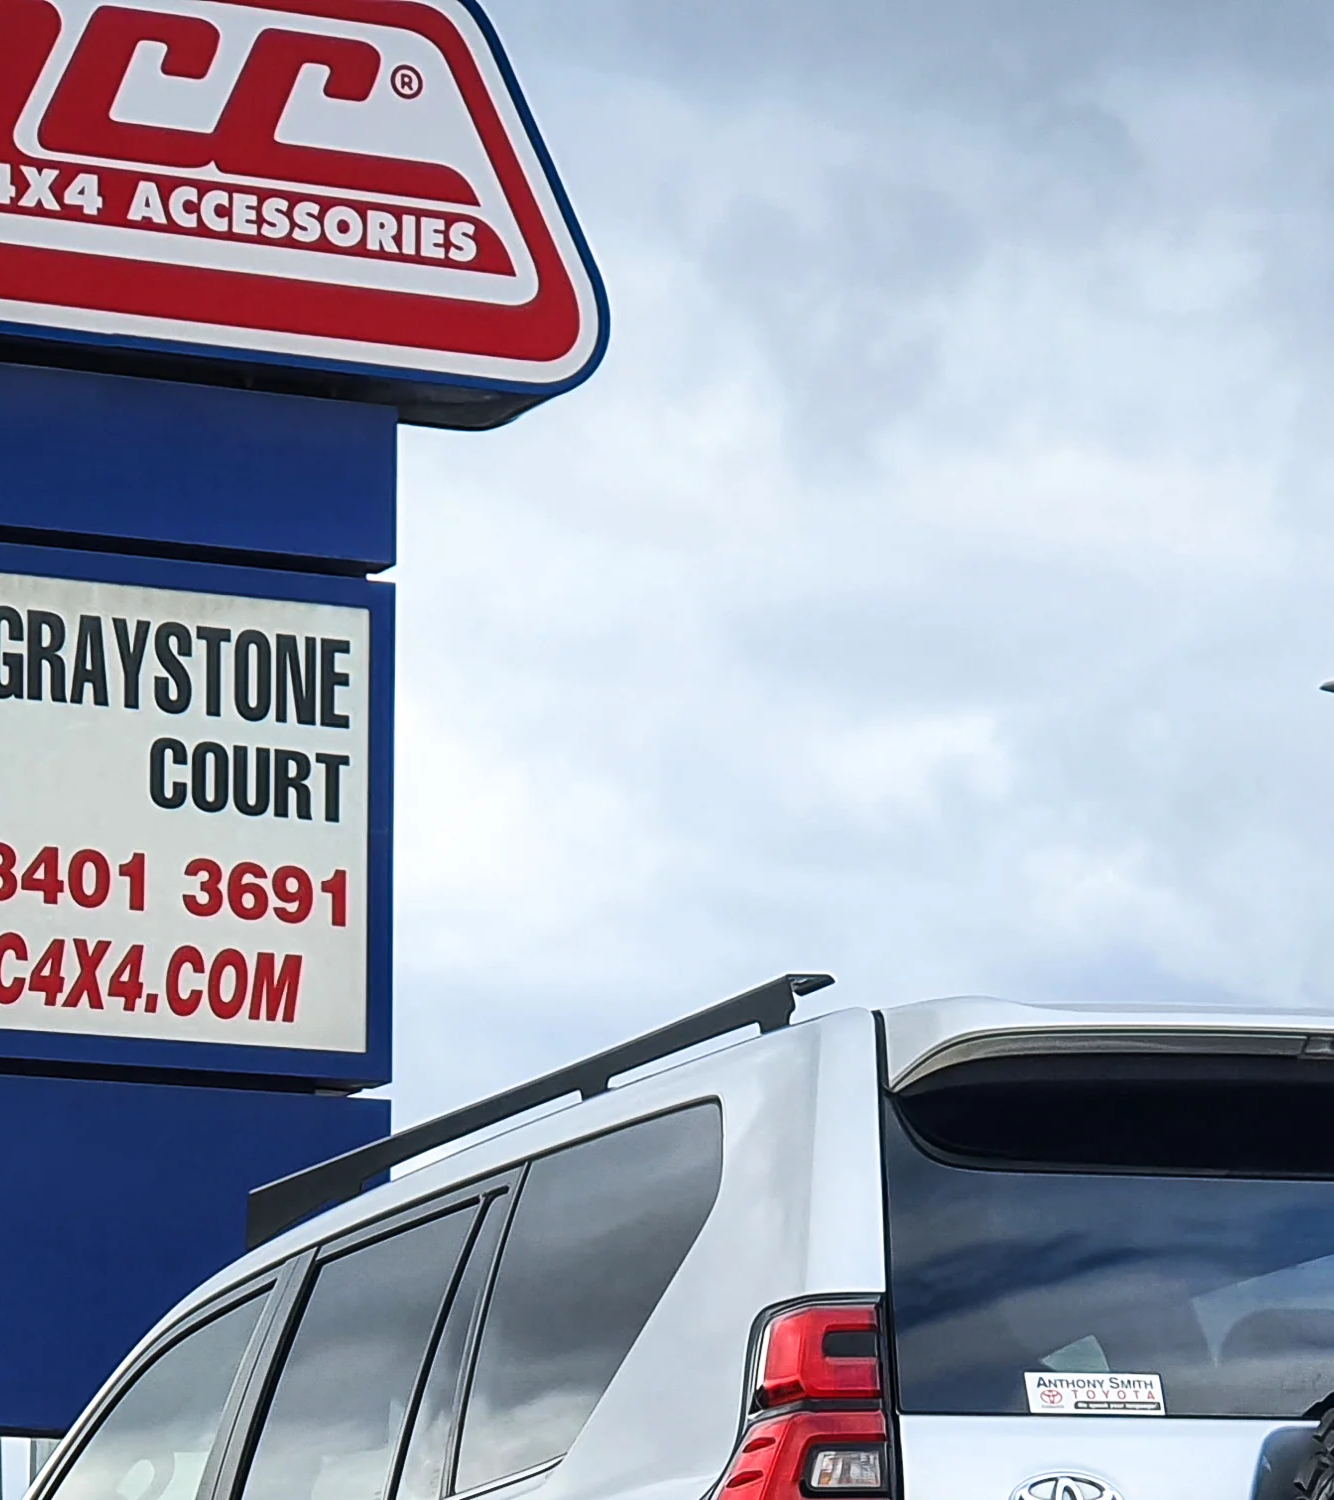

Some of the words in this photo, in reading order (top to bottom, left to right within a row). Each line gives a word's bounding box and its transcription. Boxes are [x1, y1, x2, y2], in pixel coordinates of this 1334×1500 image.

[128, 180, 478, 262] ACCESSORIES
[149, 737, 350, 823] COURT
[183, 858, 347, 926] 3691
[1072, 1389, 1155, 1400] TOYOTA
